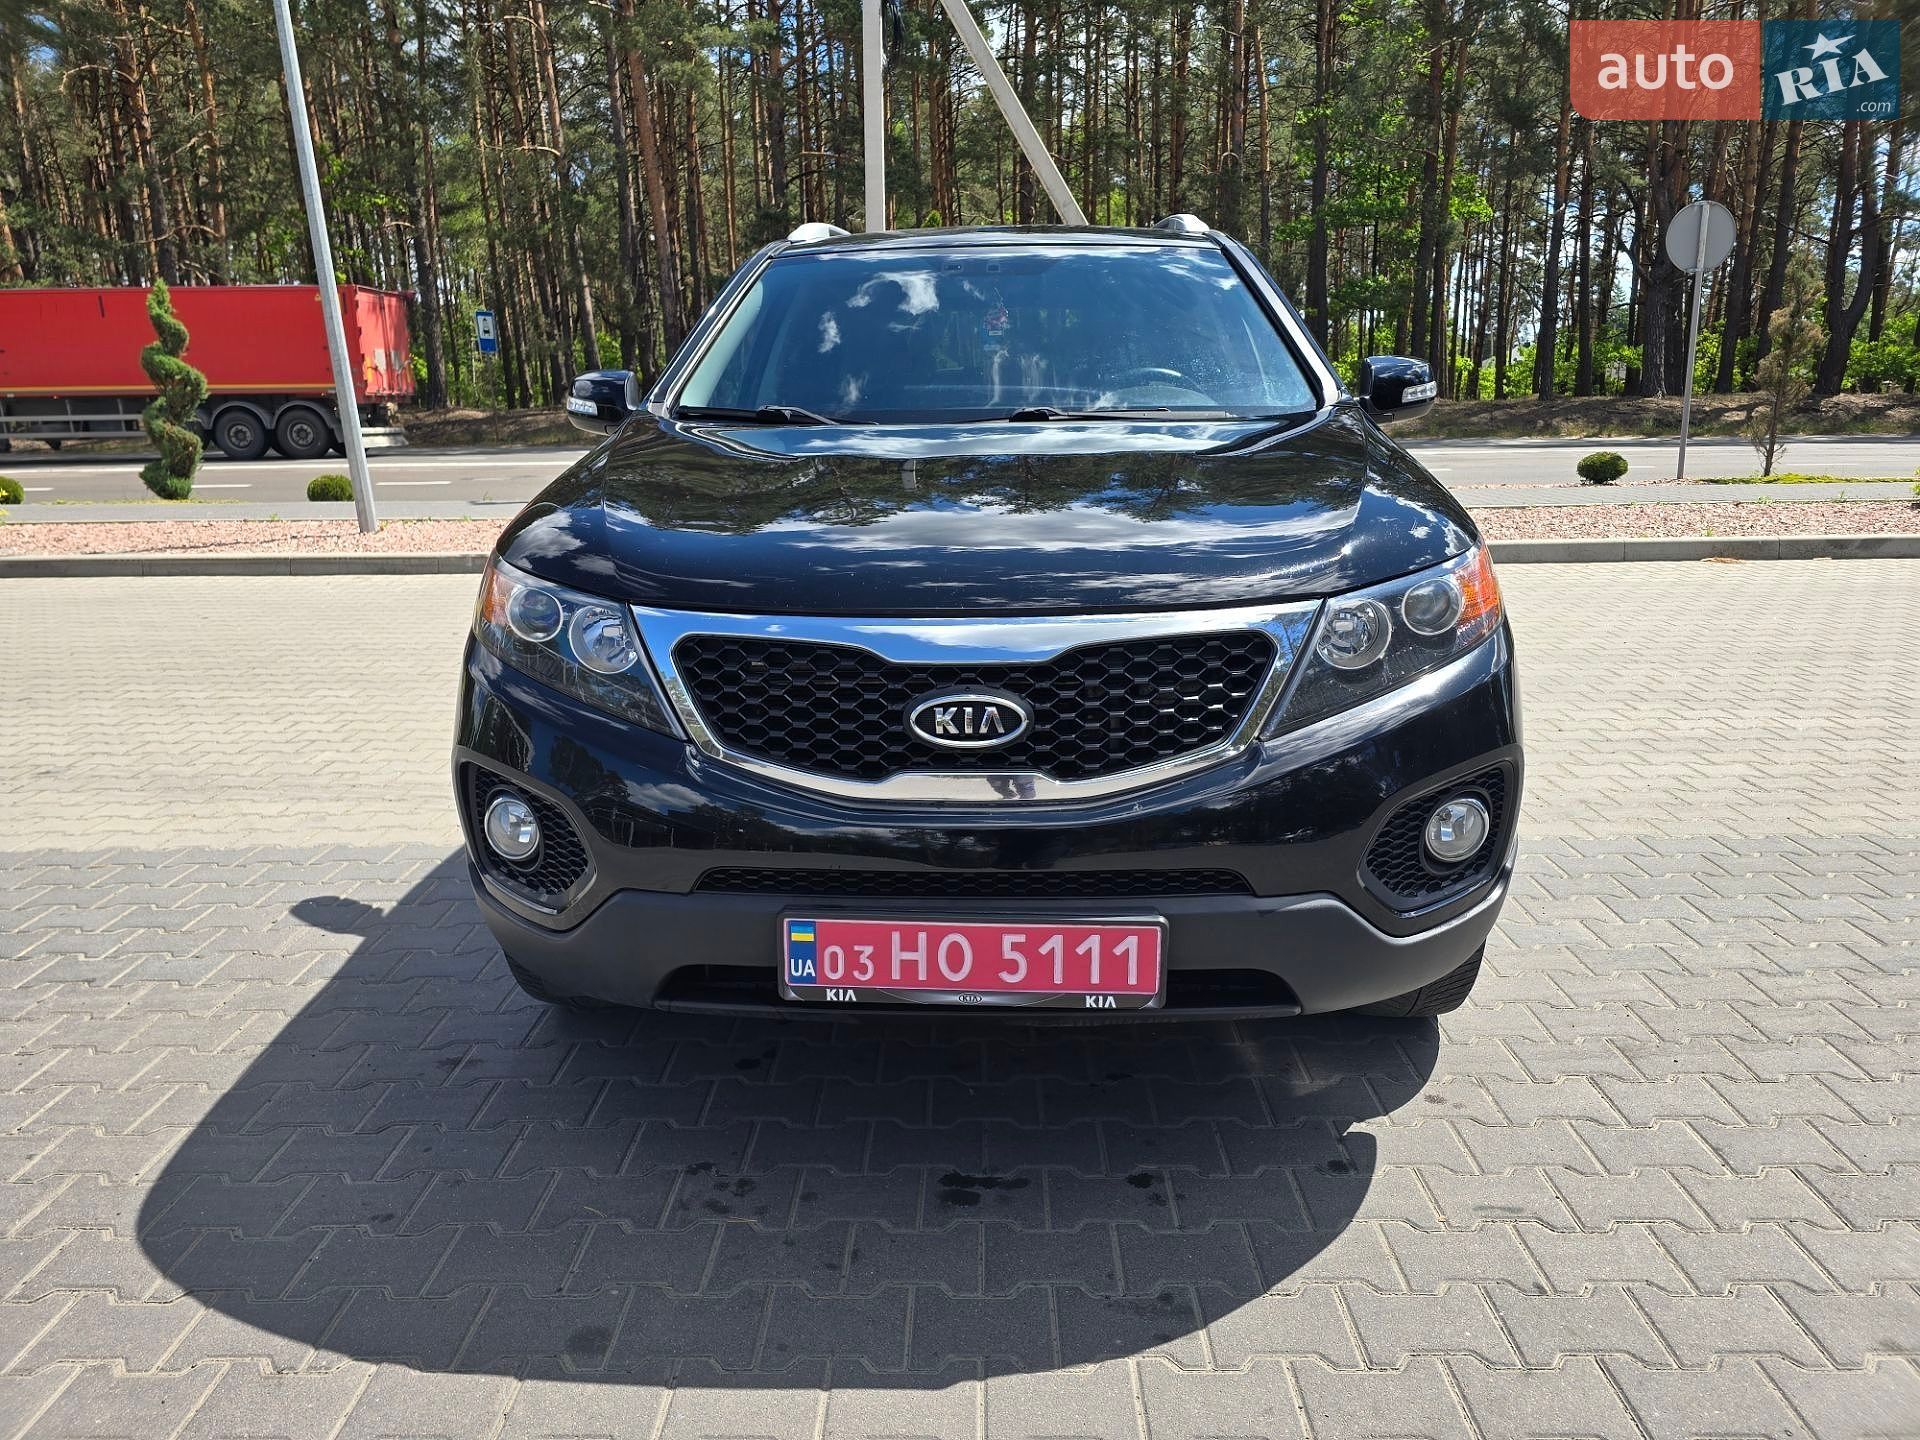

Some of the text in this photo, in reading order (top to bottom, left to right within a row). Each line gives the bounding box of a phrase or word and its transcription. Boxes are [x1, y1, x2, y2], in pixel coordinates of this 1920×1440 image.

[933, 706, 1005, 734] KIA
[823, 931, 1139, 986] 03 HO 5111
[790, 959, 816, 977] UA
[825, 988, 857, 1002] KIA
[1085, 995, 1117, 1009] KIA
